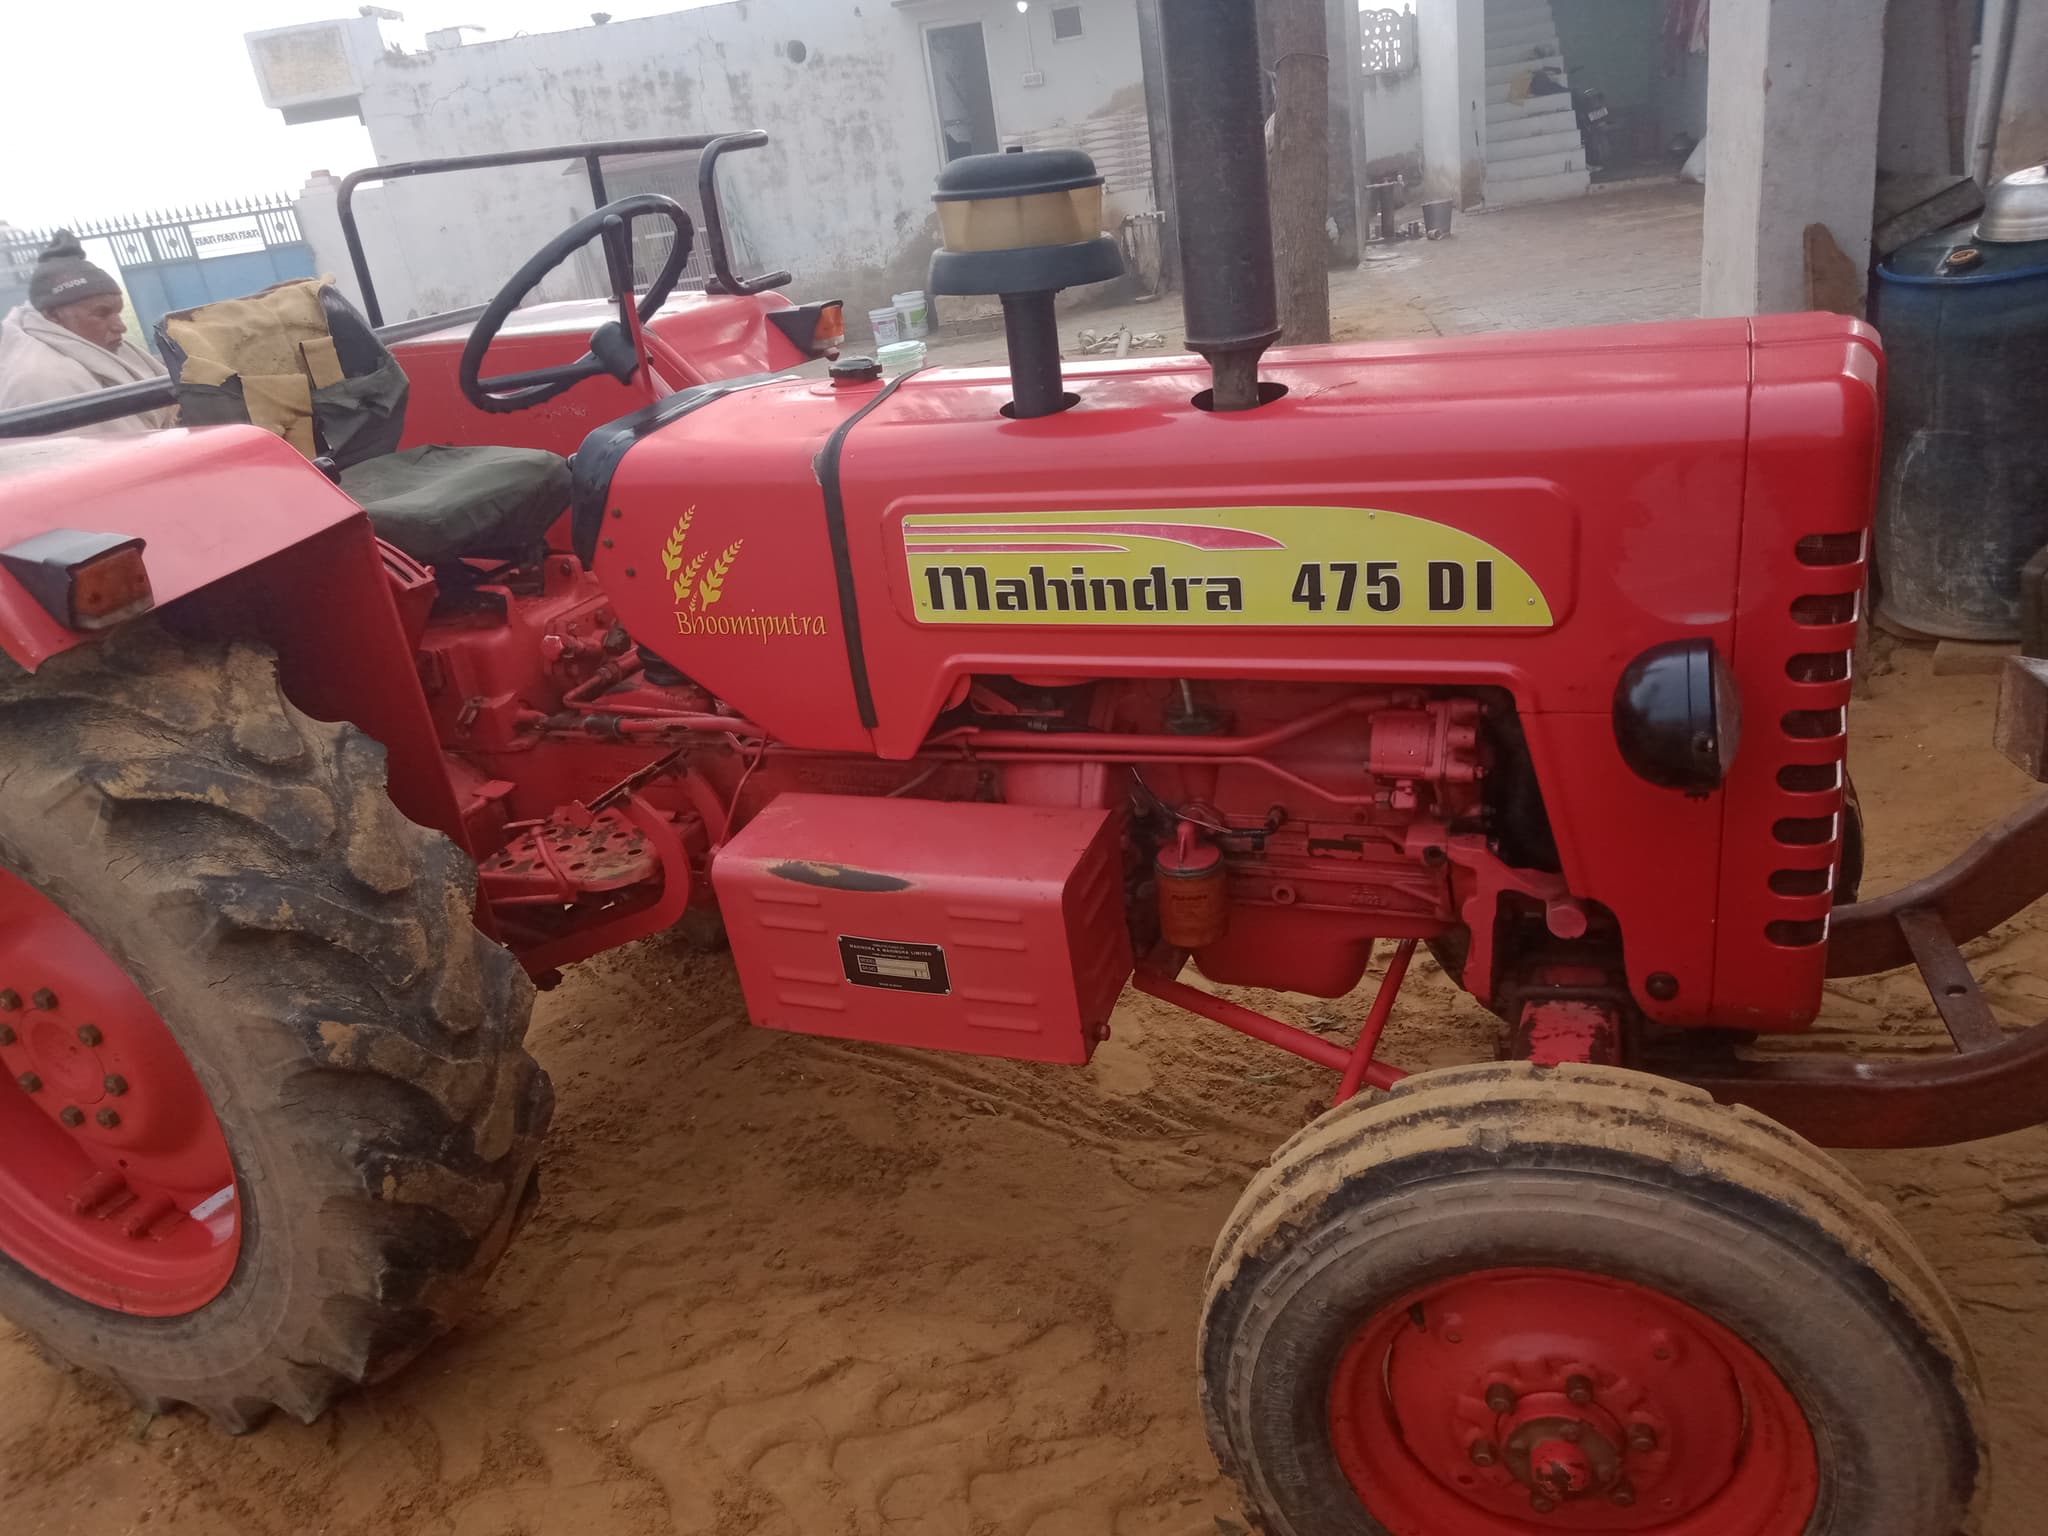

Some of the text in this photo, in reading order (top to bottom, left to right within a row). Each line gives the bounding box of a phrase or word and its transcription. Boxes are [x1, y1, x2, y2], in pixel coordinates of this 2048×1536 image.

[924, 559, 1494, 613] Mahindra 475 DI
[673, 608, 827, 645] Bhoomiputra
